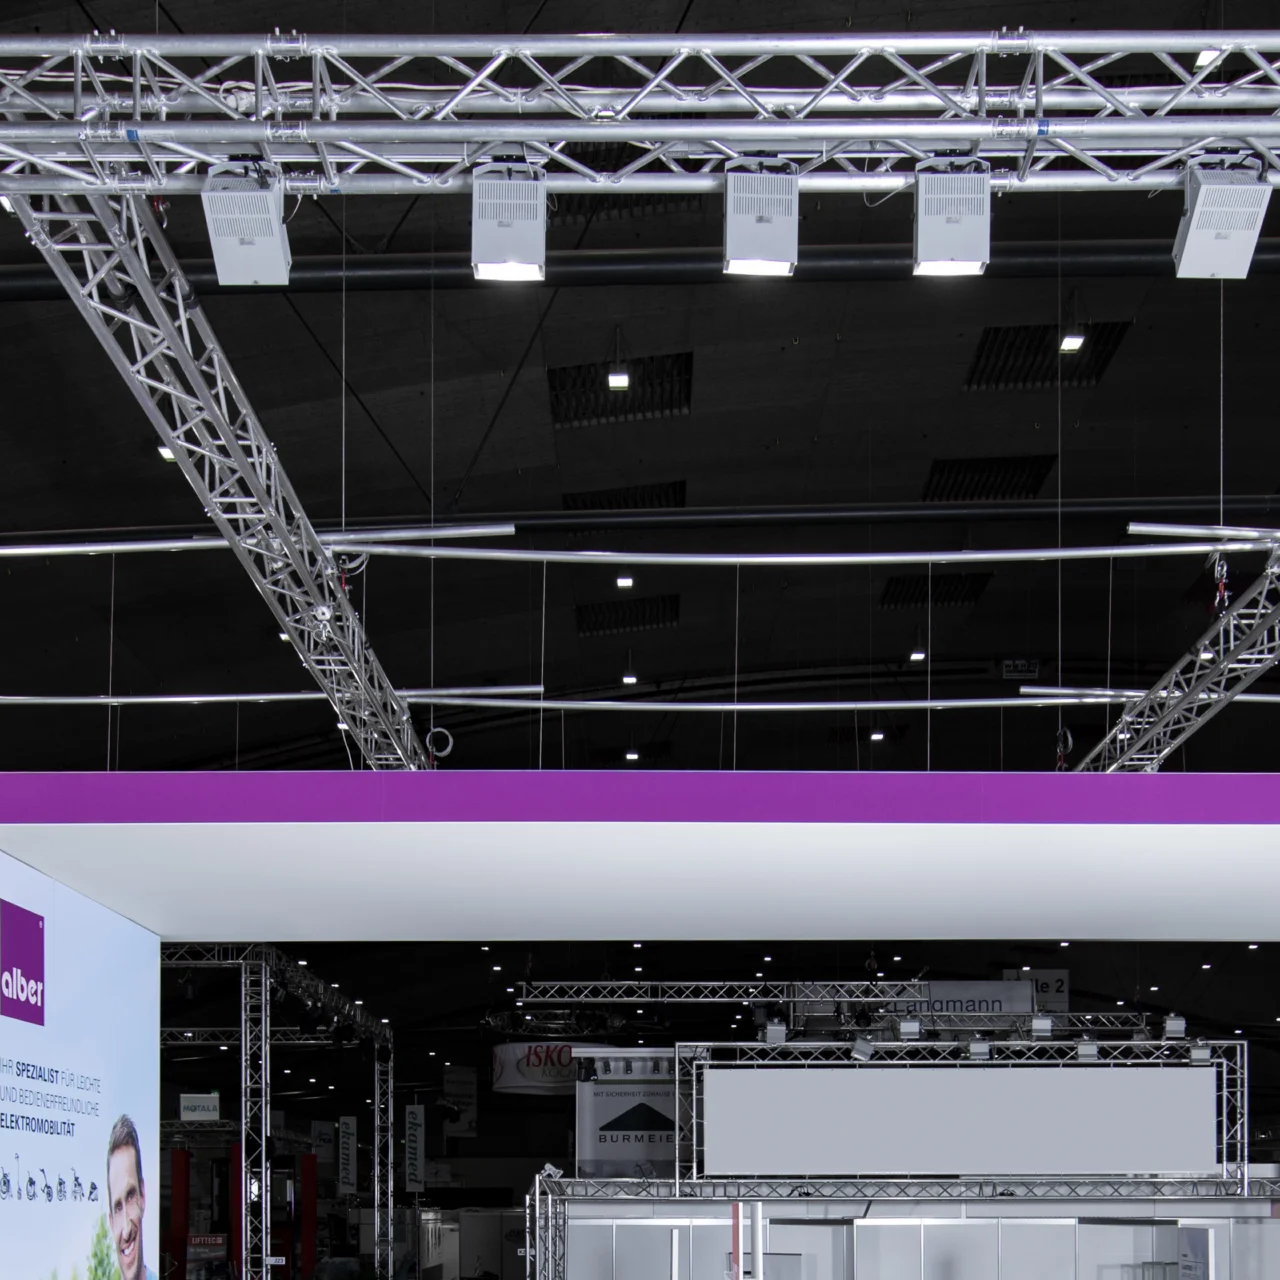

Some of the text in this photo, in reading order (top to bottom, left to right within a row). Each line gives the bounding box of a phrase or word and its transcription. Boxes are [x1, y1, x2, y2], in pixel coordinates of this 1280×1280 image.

[1, 966, 44, 1007] alber
[0, 1056, 101, 1094] IHR SPEZIALIST FÜR LEICHTE
[0, 1084, 18, 1103] UND
[0, 1112, 76, 1137] ELEKTROMOBILITÄT
[182, 1104, 219, 1113] MOTALA
[341, 1120, 356, 1188] ekamed
[407, 1110, 423, 1185] ekamed
